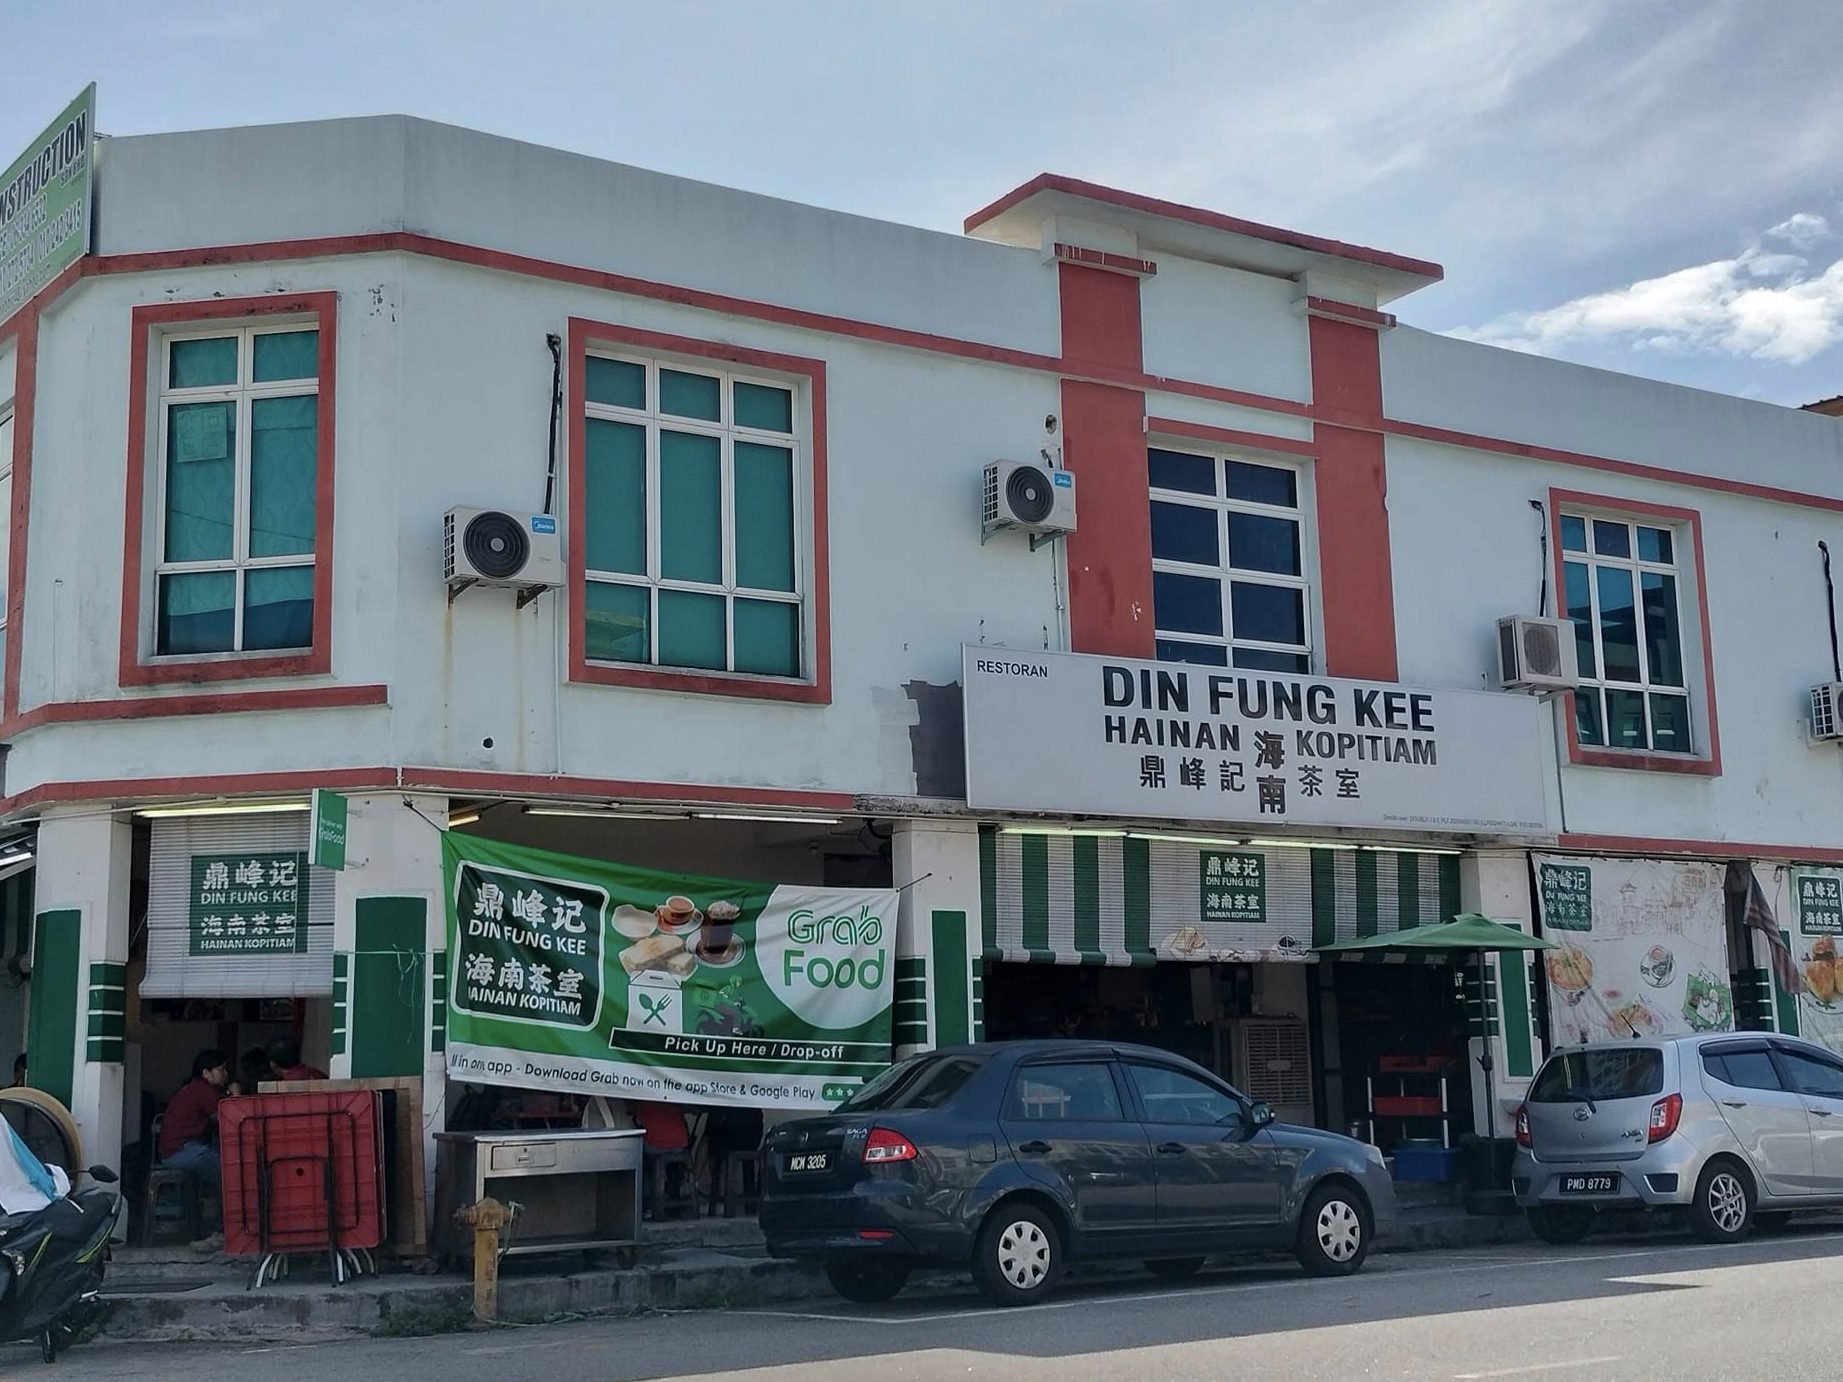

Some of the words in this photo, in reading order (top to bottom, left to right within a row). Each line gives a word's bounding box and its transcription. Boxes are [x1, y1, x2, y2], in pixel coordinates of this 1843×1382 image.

[977, 660, 1048, 678] RESTORAN
[1103, 666, 1188, 712] DIN
[1208, 675, 1336, 725] FUNG
[1354, 688, 1435, 732] KEE
[1105, 715, 1240, 751] HAINAN
[1297, 729, 1437, 766] KOPITIAM
[1140, 755, 1245, 792] 鼎峰記
[1298, 765, 1360, 799] 茶室
[1253, 730, 1286, 815] 海南
[202, 860, 297, 890] 鼎峰记
[1207, 856, 1260, 876] 鼎峰记
[1206, 877, 1220, 886] DIN
[1222, 877, 1244, 887] FUNG
[1245, 878, 1260, 887] KEE
[201, 892, 226, 904] DIN
[230, 891, 268, 904] FUNG
[272, 890, 297, 902] KEE
[473, 882, 587, 934] 鼎峰记
[1207, 892, 1260, 909] 海南茶室
[201, 911, 296, 936] 海南茶室
[787, 905, 883, 945] Grab
[201, 939, 243, 949] HAINAN
[244, 938, 295, 948] KOPITIAM
[468, 919, 501, 939] DIN
[504, 925, 552, 950] FUNG
[556, 936, 586, 956] KEE
[465, 953, 584, 1000] 海南茶室
[784, 949, 885, 990] Food
[520, 994, 581, 1016] KOPITIAM
[665, 1037, 699, 1052] Pick
[706, 1039, 727, 1055] Up
[732, 1042, 766, 1056] Here
[771, 1043, 777, 1057] /
[781, 1045, 844, 1060] Drop-off
[459, 1055, 469, 1068] in
[488, 1060, 513, 1075] app
[525, 1063, 587, 1083] Download
[591, 1071, 620, 1085] Grab
[647, 1079, 660, 1089] on
[664, 1078, 681, 1090] the
[685, 1082, 708, 1095] app
[710, 1082, 737, 1095] Store
[740, 1084, 746, 1095] &
[750, 1084, 789, 1099] Google
[793, 1086, 815, 1101] Play
[807, 1154, 827, 1169] 3205
[1587, 1178, 1611, 1190] 8779
